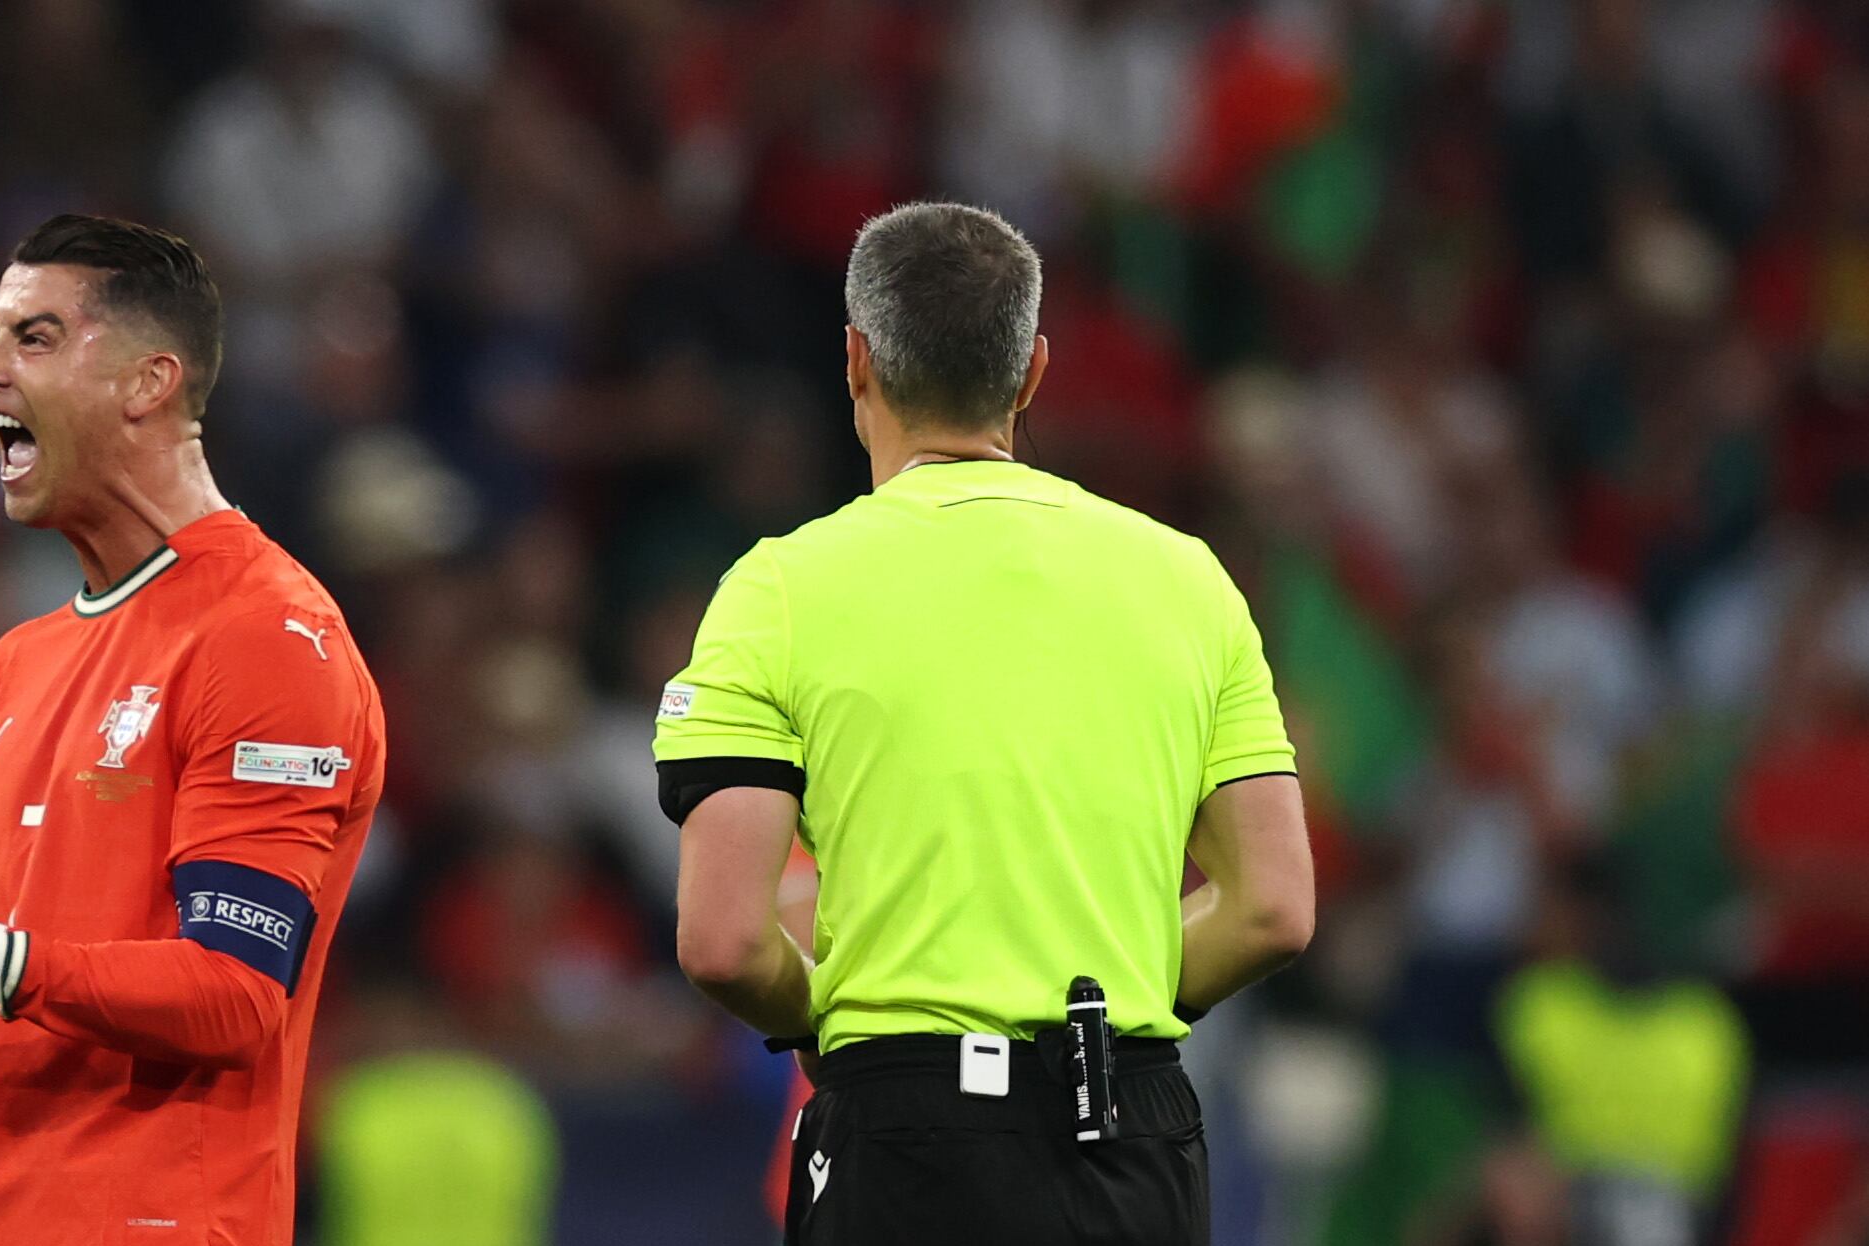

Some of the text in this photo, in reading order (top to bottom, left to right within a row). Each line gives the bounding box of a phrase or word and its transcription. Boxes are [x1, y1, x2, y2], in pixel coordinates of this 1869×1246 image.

[662, 693, 691, 708] TION
[312, 756, 333, 777] 10
[215, 899, 293, 942] RESPECT
